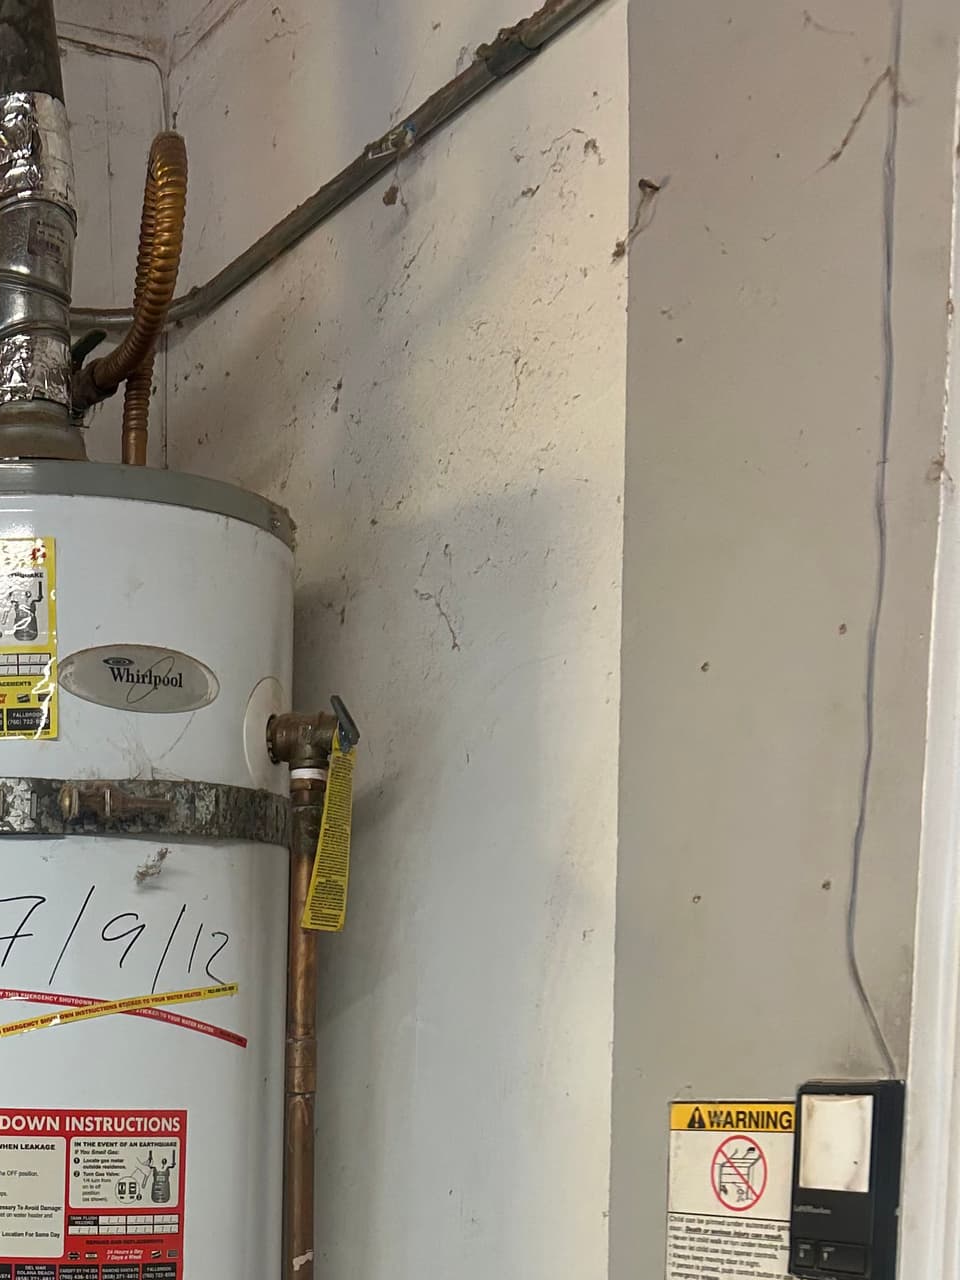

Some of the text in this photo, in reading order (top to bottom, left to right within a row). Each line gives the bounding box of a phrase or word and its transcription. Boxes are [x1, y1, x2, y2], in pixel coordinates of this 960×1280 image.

[108, 666, 183, 691] Whirlpool
[20, 992, 58, 1002] EMERGENCY
[3, 1020, 39, 1033] EMERGENCY
[75, 1003, 118, 1017] INSTRUCTIONS
[150, 995, 166, 1003] YOUR
[167, 993, 183, 1001] WATER
[183, 991, 202, 999] HEATER
[65, 1116, 181, 1132] INSTRUCTIONS
[707, 1109, 793, 1131] WARNING
[20, 1143, 56, 1151] LEAKAGE
